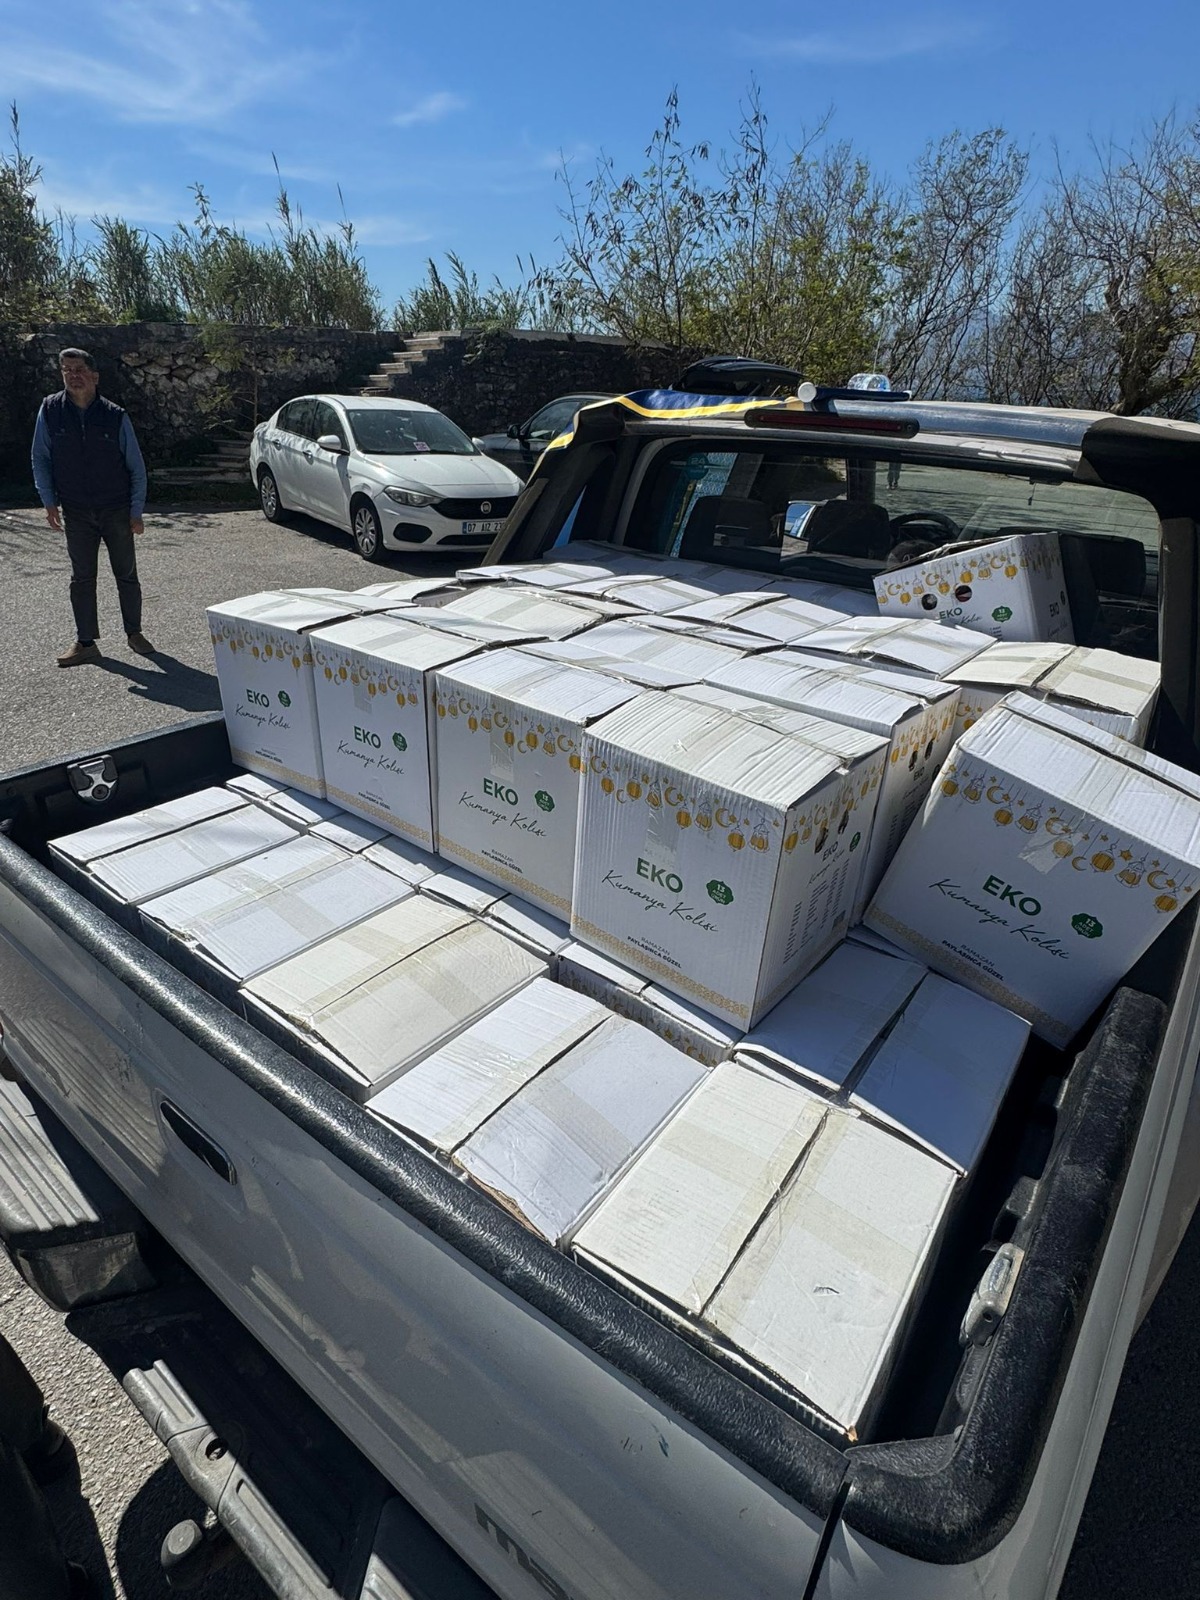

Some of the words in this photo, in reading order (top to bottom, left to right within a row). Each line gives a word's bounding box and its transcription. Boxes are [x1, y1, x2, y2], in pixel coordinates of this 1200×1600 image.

[467, 523, 476, 533] 07
[939, 607, 963, 620] EKO
[246, 688, 270, 708] EKO
[353, 725, 382, 749] EKO
[337, 739, 376, 768] Kumanya
[483, 777, 519, 806] EKO
[458, 791, 508, 825] Kumanya
[509, 812, 547, 837] Kolisi
[822, 841, 839, 861] EKO
[636, 857, 684, 894] EKO
[717, 884, 726, 893] 13
[982, 874, 1042, 916] EKO
[601, 869, 667, 911] Kumanya
[668, 901, 719, 932] Kolisi
[928, 878, 1010, 927] Kumanya
[1009, 924, 1070, 960] Kolisi
[1078, 921, 1095, 932] ADET
[1085, 918, 1096, 928] 13
[641, 936, 671, 956] RAMAZAN
[960, 943, 995, 968] RAMAZAN
[662, 953, 683, 969] GÜZEL
[982, 964, 1005, 982] GÜZEL
